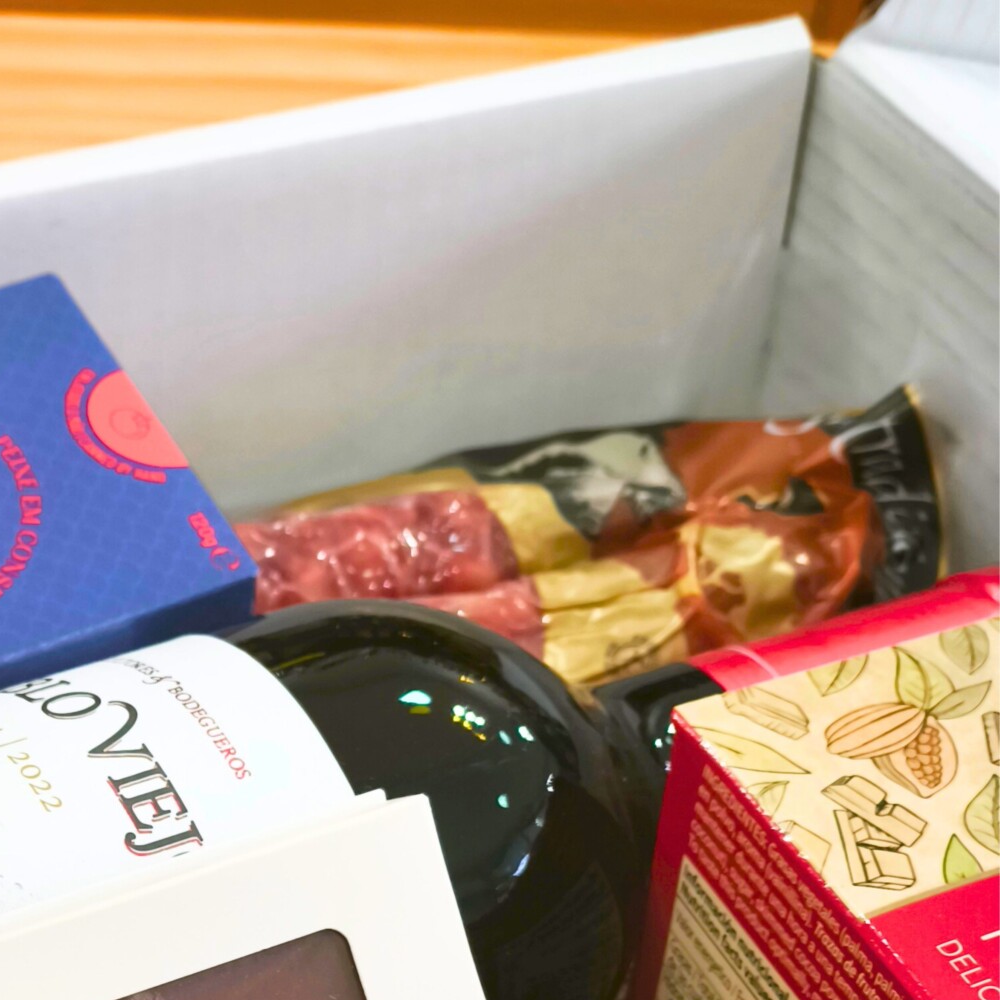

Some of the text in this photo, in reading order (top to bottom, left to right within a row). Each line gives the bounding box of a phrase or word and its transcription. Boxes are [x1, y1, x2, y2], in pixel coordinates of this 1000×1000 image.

[20, 495, 42, 525] EM
[166, 684, 251, 781] BODEGUEROS
[7, 752, 63, 812] 2022
[88, 700, 203, 858] VIEJ
[814, 921, 844, 964] Trazas
[845, 957, 858, 979] de
